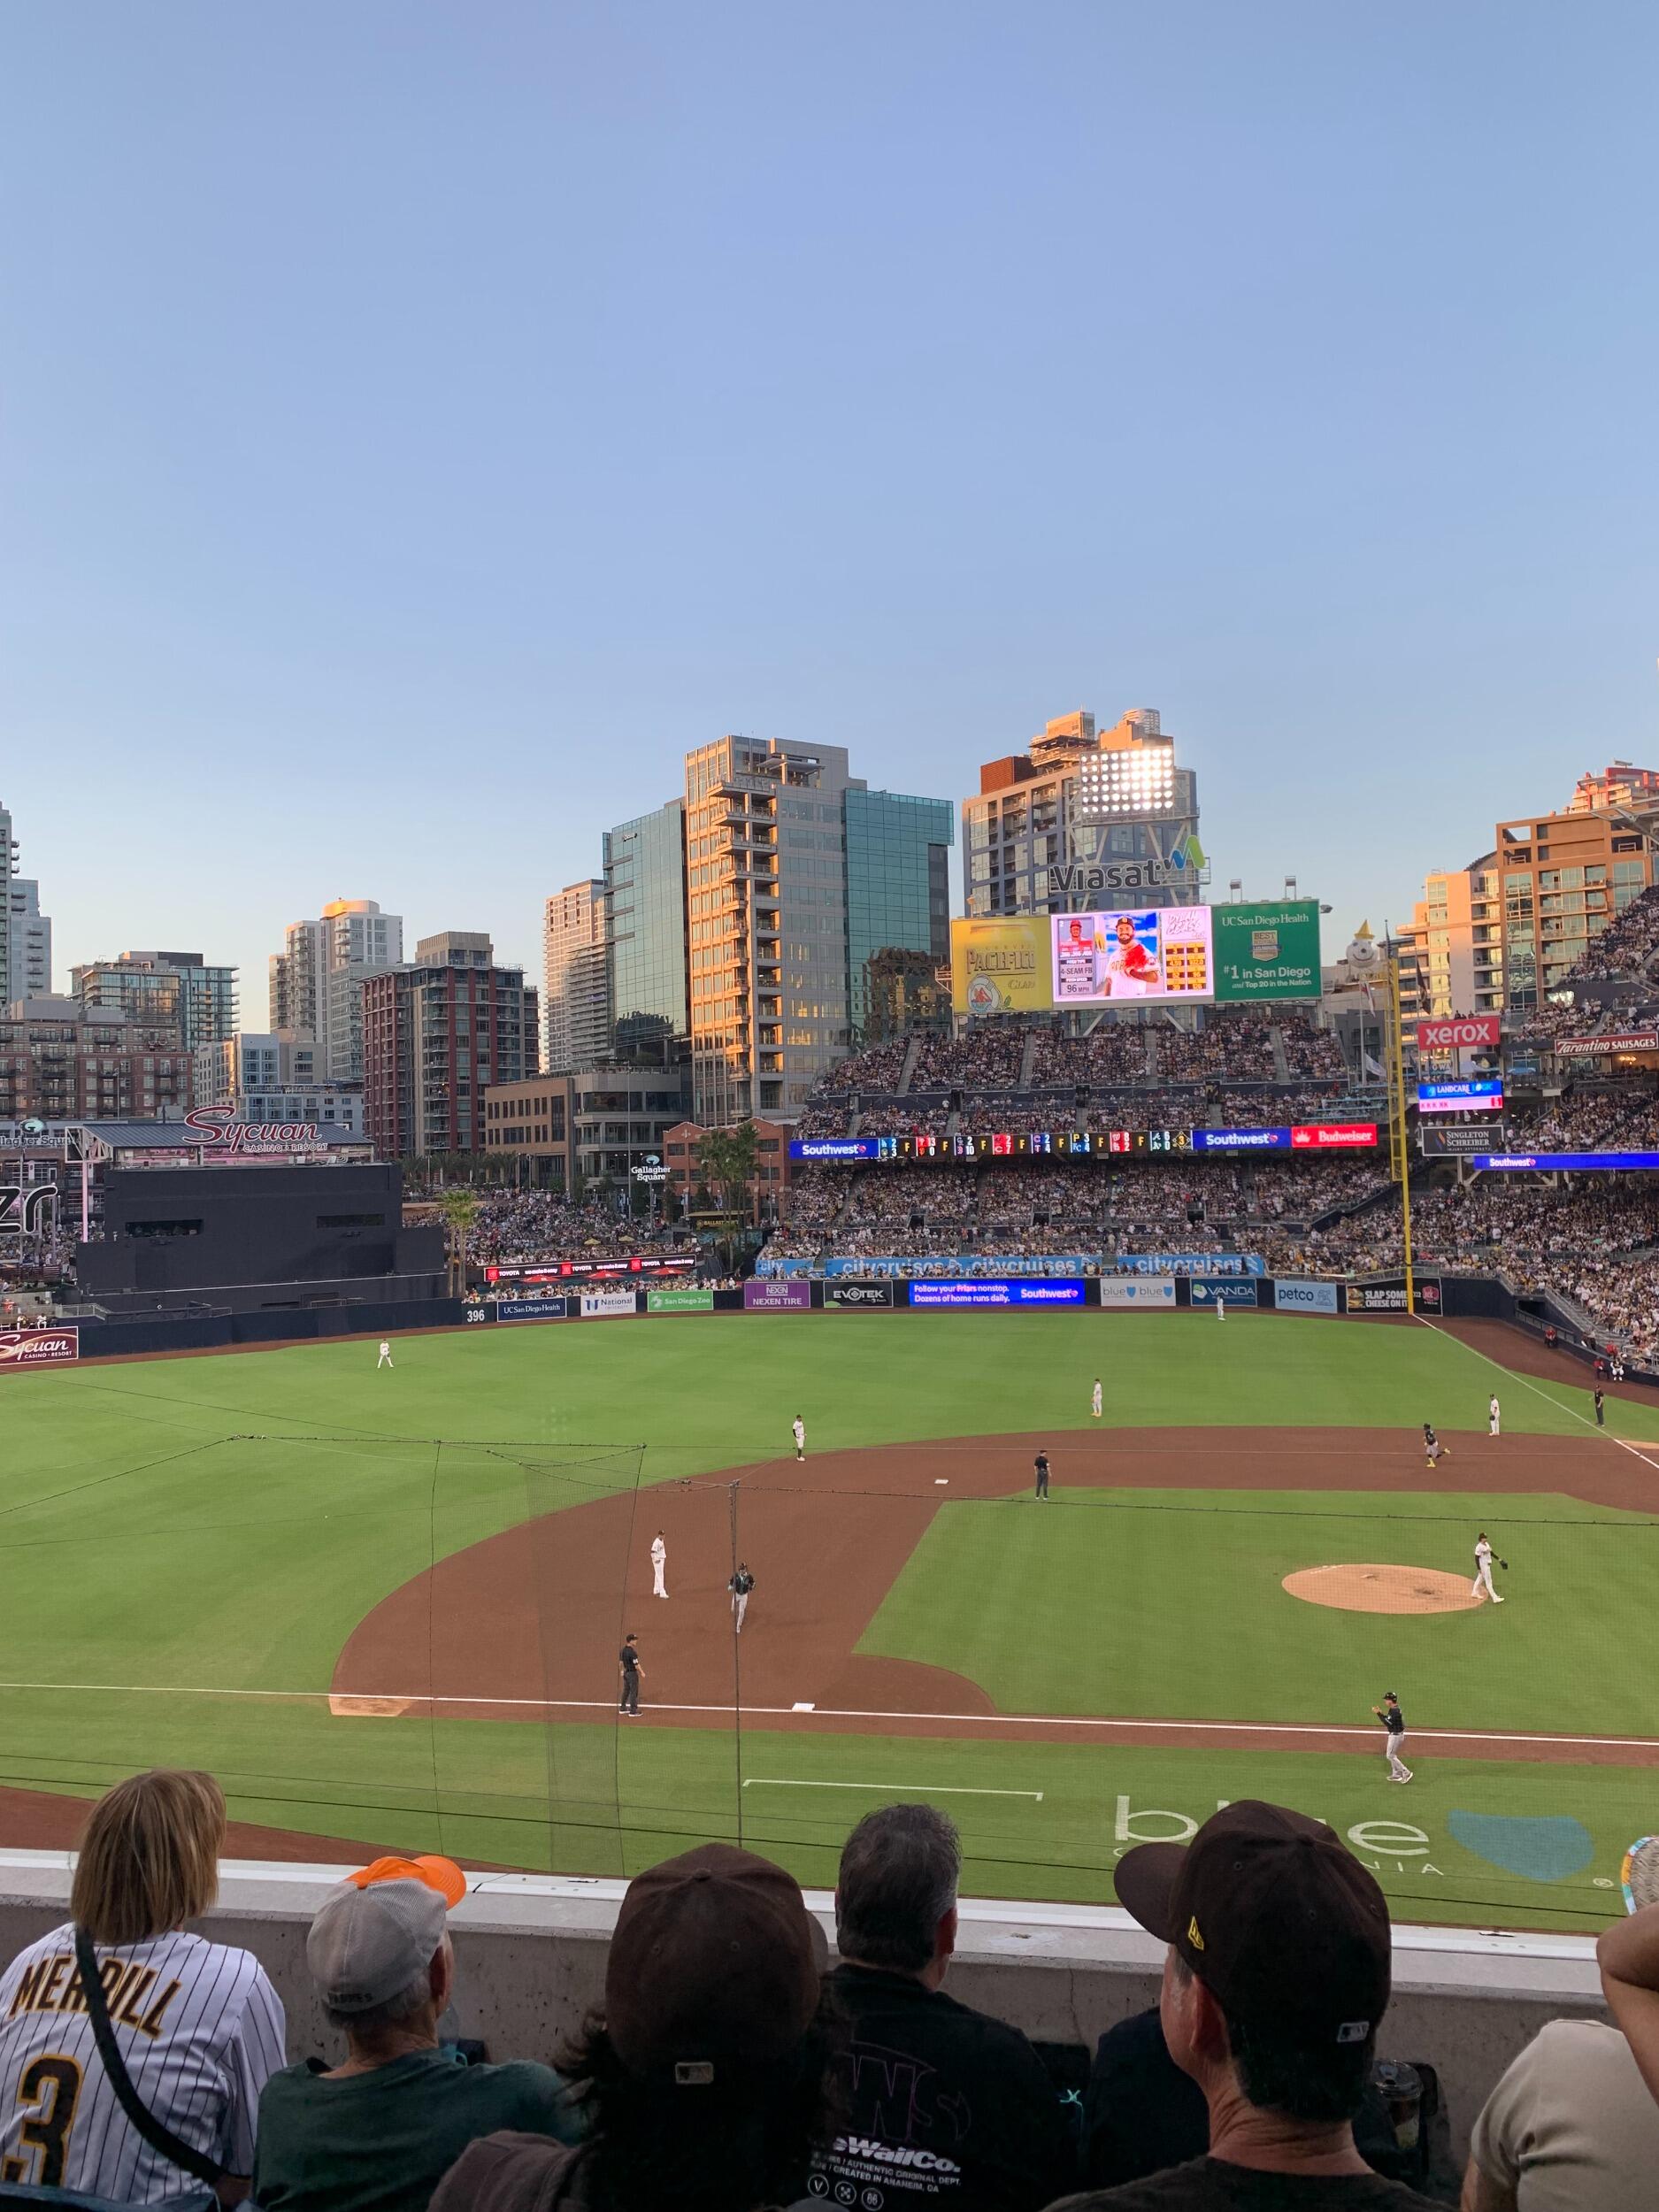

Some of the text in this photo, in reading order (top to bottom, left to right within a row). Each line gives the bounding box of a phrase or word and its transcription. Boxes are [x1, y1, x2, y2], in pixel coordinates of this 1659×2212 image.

[1051, 858, 1161, 892] Viasat
[1222, 913, 1309, 926] UC San Diego Health
[1224, 964, 1310, 979] #1 in San Diego
[1425, 1023, 1490, 1046] xerox
[1557, 1038, 1655, 1054] Tarantino SAUSAGES
[1437, 1084, 1470, 1094] LANDCARE
[182, 1105, 322, 1153] Sycuan
[1006, 1135, 1010, 1145] 2
[1045, 1134, 1050, 1143] 2
[1084, 1133, 1089, 1142] 3
[1179, 1136, 1184, 1145] 3
[1206, 1133, 1269, 1145] Southwest
[1318, 1131, 1372, 1142] Budweiser
[1447, 1131, 1489, 1140] SINGLETON
[892, 1138, 896, 1148] 2
[943, 1141, 948, 1151] F
[981, 1141, 986, 1150] F
[1020, 1140, 1025, 1148] F
[1059, 1138, 1064, 1148] F
[1099, 1138, 1103, 1147] F
[1139, 1136, 1144, 1146] F
[1164, 1141, 1171, 1150] 0
[243, 1144, 282, 1153] CASINO
[803, 1144, 858, 1156] Southwest
[904, 1142, 910, 1152] F
[929, 1147, 934, 1156] 0
[966, 1146, 974, 1155] 10
[1006, 1145, 1010, 1154] 7
[1045, 1144, 1051, 1153] 4
[1085, 1143, 1090, 1152] 4
[1124, 1142, 1130, 1151] 2
[892, 1148, 896, 1156] 3
[1490, 1157, 1530, 1167] Southwest
[631, 1166, 672, 1175] Gallagher
[637, 1173, 665, 1182] Square
[972, 1258, 1076, 1272] citycruises
[1138, 1256, 1241, 1271] citycruises
[1020, 1288, 1071, 1299] Southwest
[1103, 1286, 1125, 1296] blue
[1140, 1286, 1163, 1296] blue
[1208, 1286, 1255, 1296] VANDA
[1279, 1287, 1314, 1302] petco
[1365, 1290, 1385, 1299] SLAP
[1386, 1290, 1408, 1299] SOME
[602, 1297, 633, 1306] National
[991, 1294, 1010, 1303] daily.
[1365, 1299, 1389, 1308] CHEESE
[526, 1305, 542, 1314] Diego
[467, 1310, 485, 1323] 396
[0, 1334, 69, 1361] Sycuan
[1115, 1795, 1430, 1855] be
[3, 2053, 83, 2187] 3
[848, 2159, 894, 2177] AUTHENTIC
[895, 2170, 936, 2185] ORIGINAL
[833, 2165, 872, 2181] CREATED
[926, 2184, 940, 2193] CA
